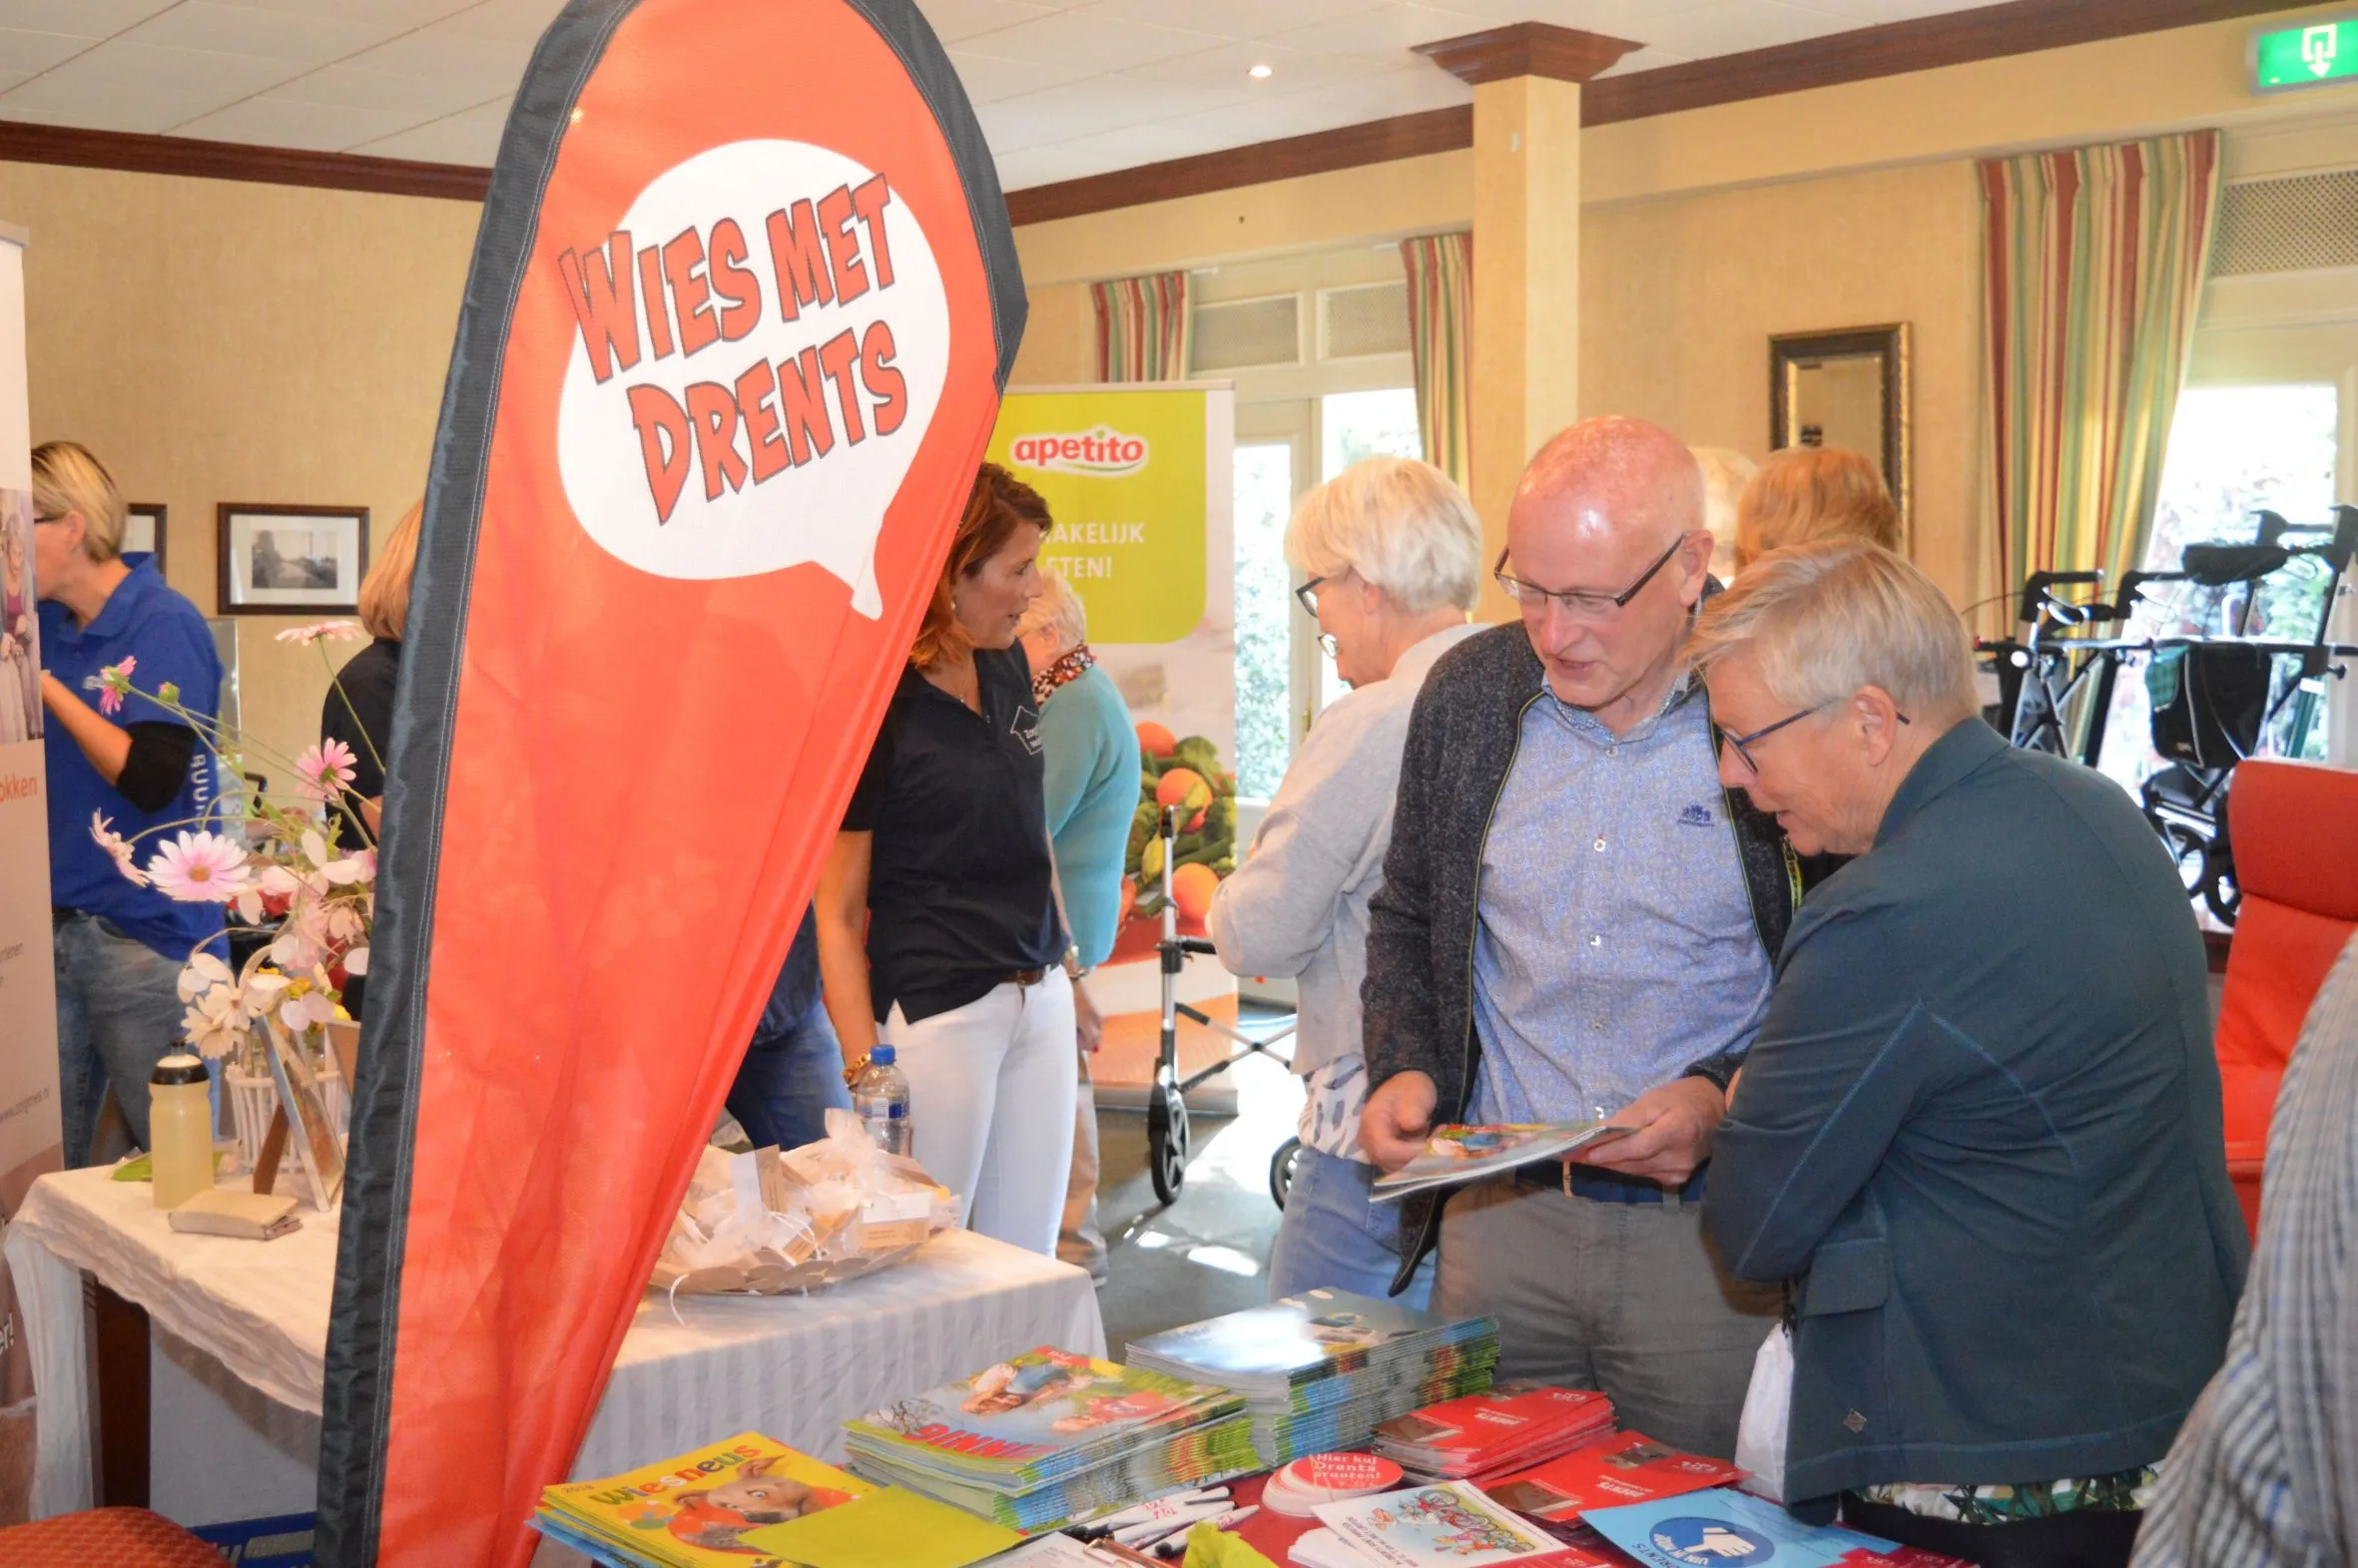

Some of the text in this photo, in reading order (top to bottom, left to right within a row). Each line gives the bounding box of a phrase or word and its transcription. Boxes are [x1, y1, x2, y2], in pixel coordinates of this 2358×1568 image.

[558, 172, 895, 386] WIES MET
[626, 319, 908, 527] DRENTS
[1014, 431, 1144, 467] apetito
